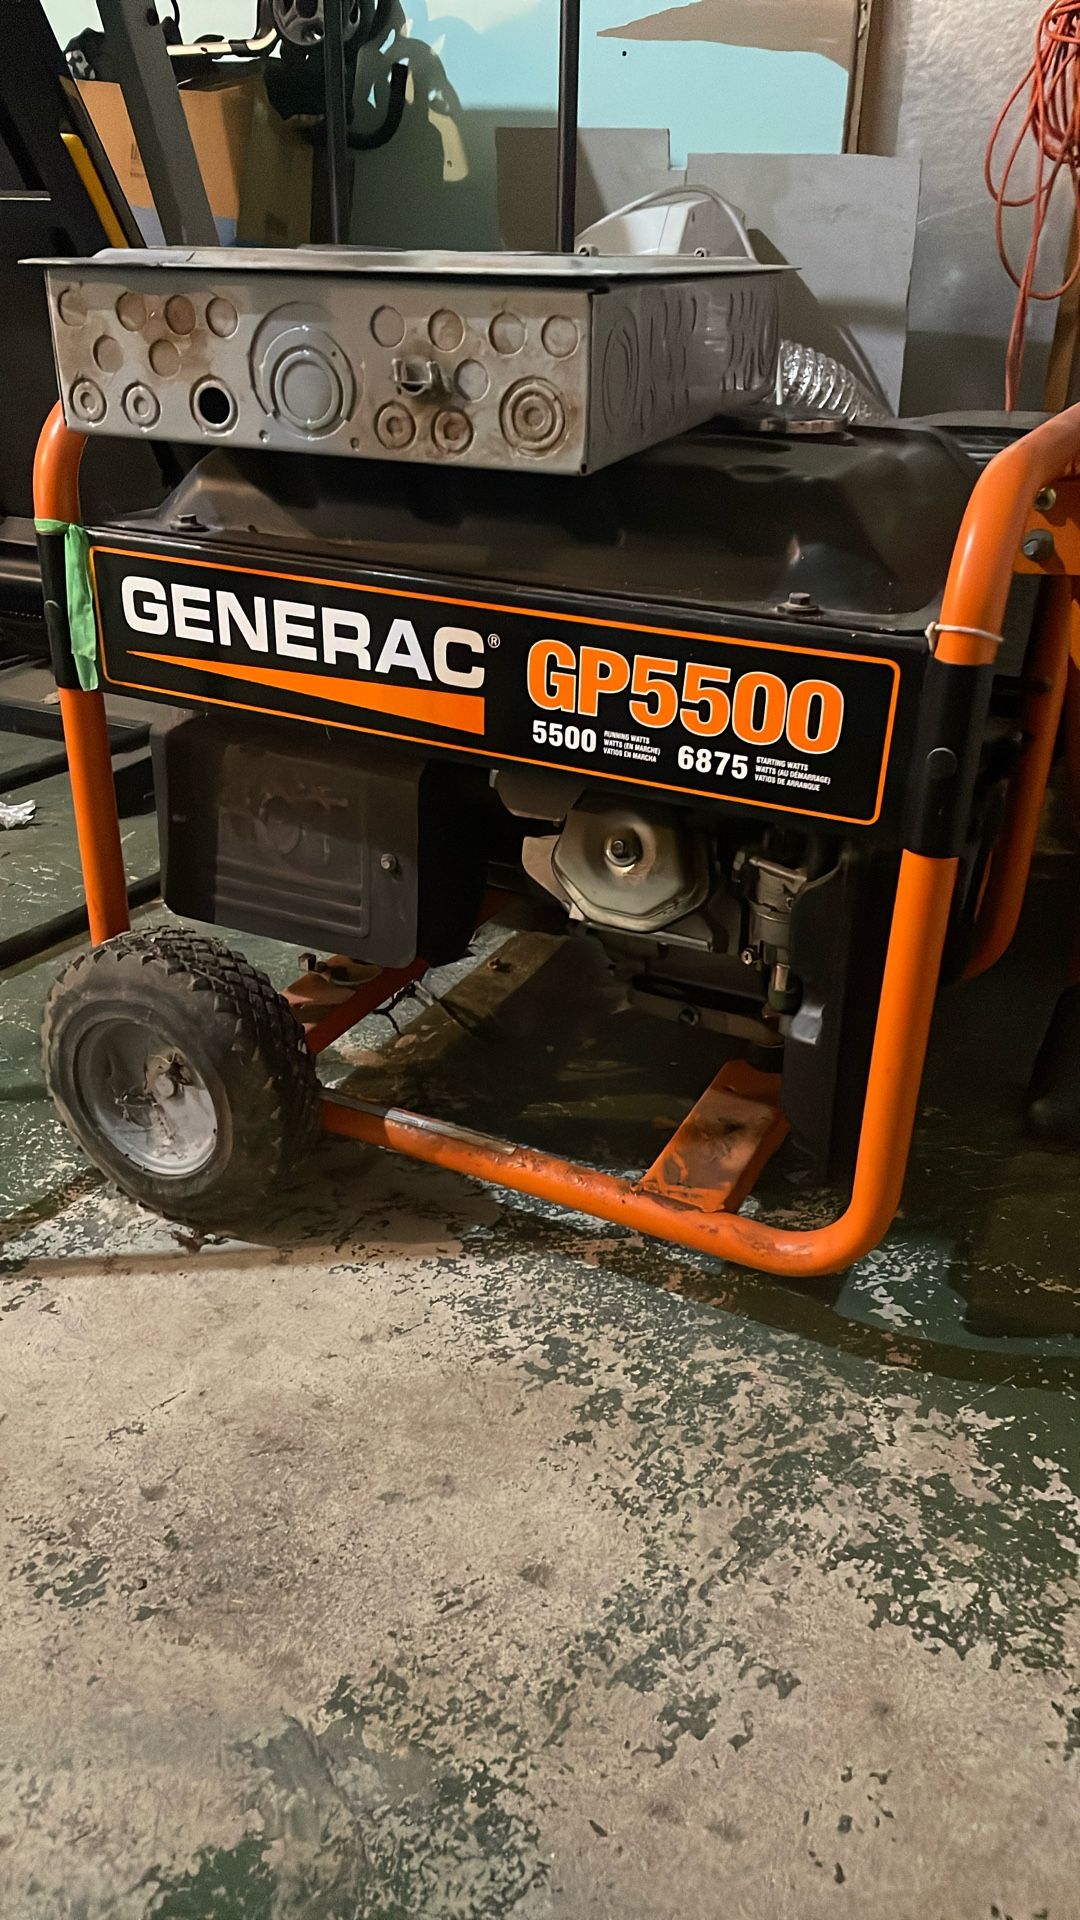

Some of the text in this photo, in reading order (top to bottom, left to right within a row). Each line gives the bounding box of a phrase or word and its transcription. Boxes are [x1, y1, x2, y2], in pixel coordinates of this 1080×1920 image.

[526, 638, 845, 755] GP5500
[532, 719, 597, 753] 5500
[603, 738, 623, 748] WATTS
[630, 734, 650, 745] WATTS
[603, 747, 657, 763] VATIOS EN MARCHA
[677, 745, 749, 780] 6875
[755, 764, 776, 775] WATTS
[777, 768, 789, 777] (AU
[756, 756, 809, 772] STARTING WATTS
[754, 773, 820, 792] VATIOS DE ARRANQUE
